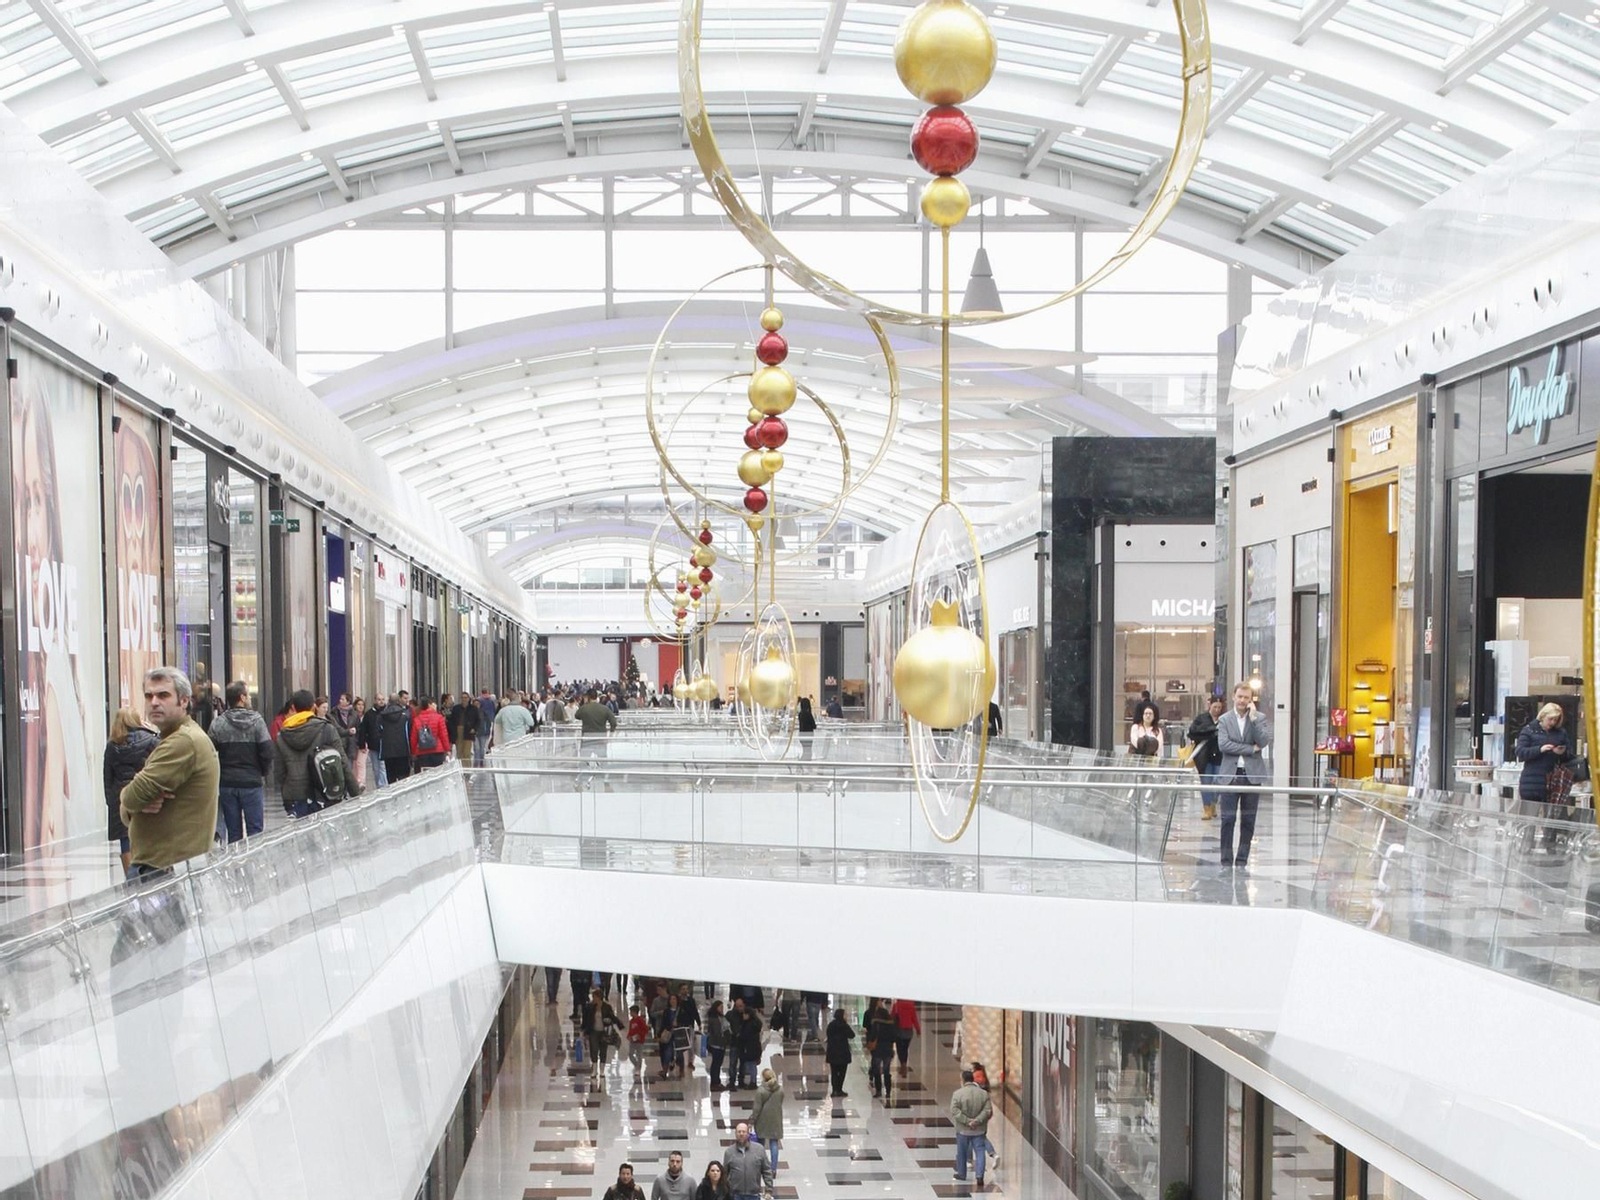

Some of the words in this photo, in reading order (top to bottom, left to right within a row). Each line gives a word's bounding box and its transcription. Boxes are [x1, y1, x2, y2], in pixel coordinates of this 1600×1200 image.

[1507, 345, 1568, 445] Douglas
[25, 554, 79, 655] LOVE
[118, 567, 158, 652] LOVE
